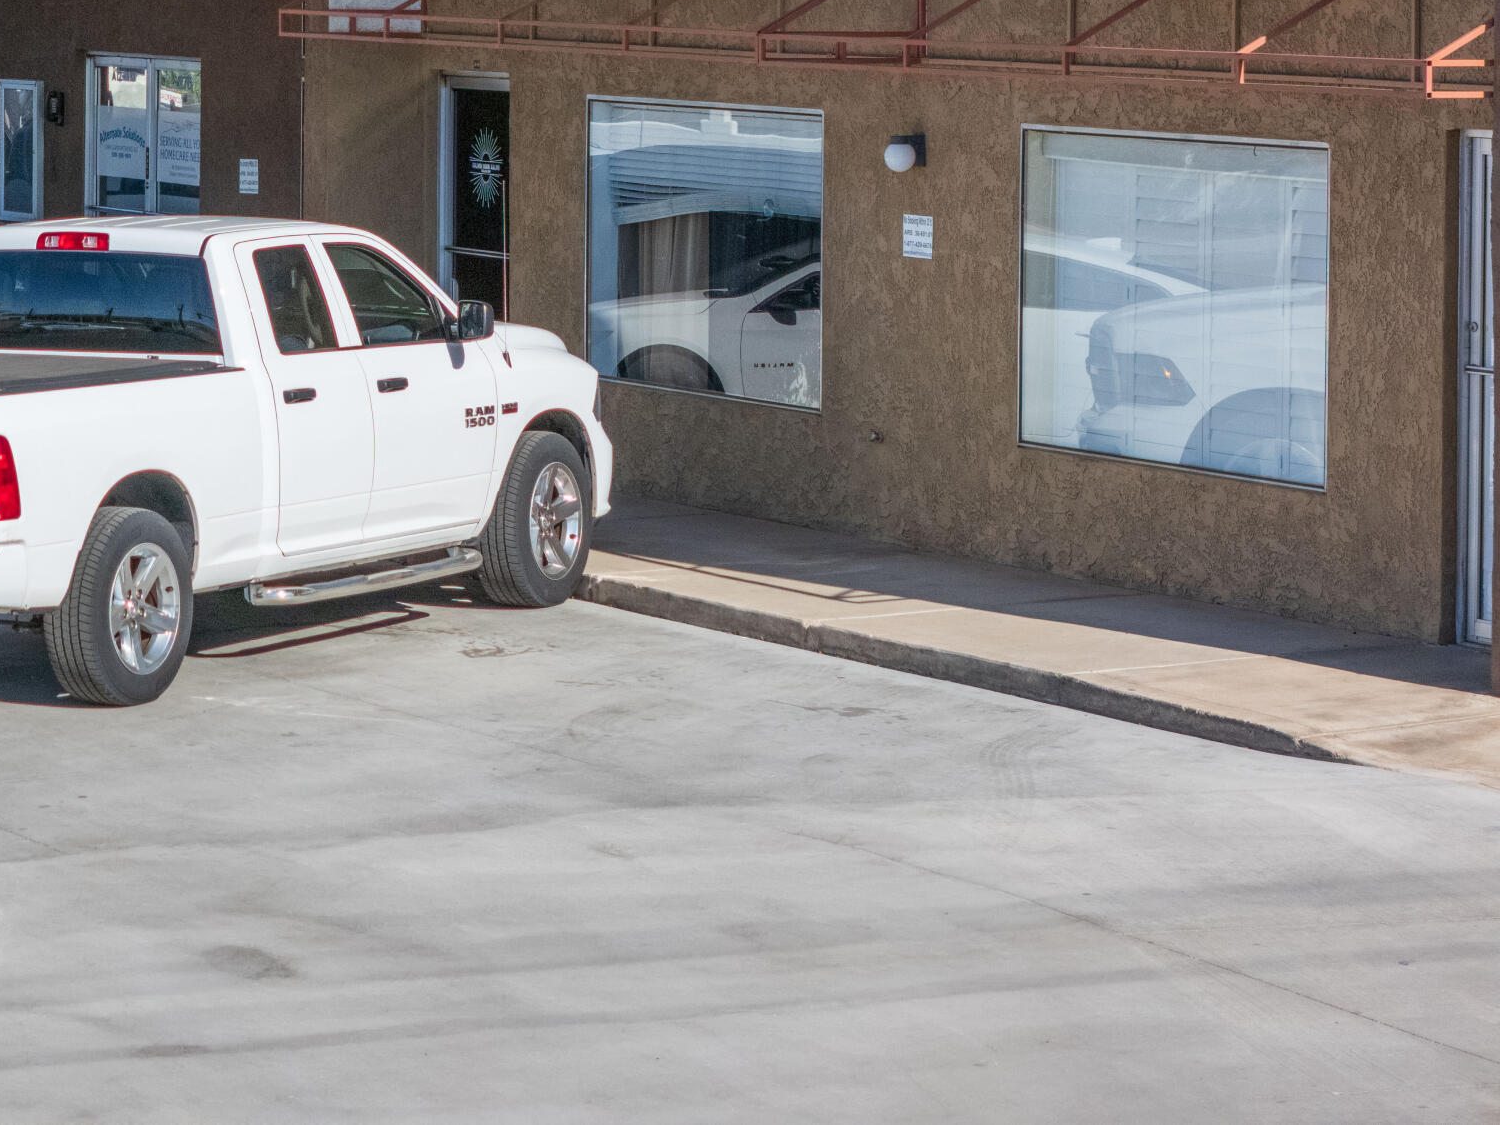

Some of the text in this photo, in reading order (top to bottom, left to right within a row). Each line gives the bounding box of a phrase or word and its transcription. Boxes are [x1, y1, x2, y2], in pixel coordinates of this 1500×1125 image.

[100, 126, 146, 148] Alternate Solutions
[160, 135, 181, 148] SERVING
[183, 139, 192, 149] ALL
[160, 149, 200, 163] HOMECARE NEE
[464, 405, 495, 417] RAM
[464, 415, 495, 428] 1500
